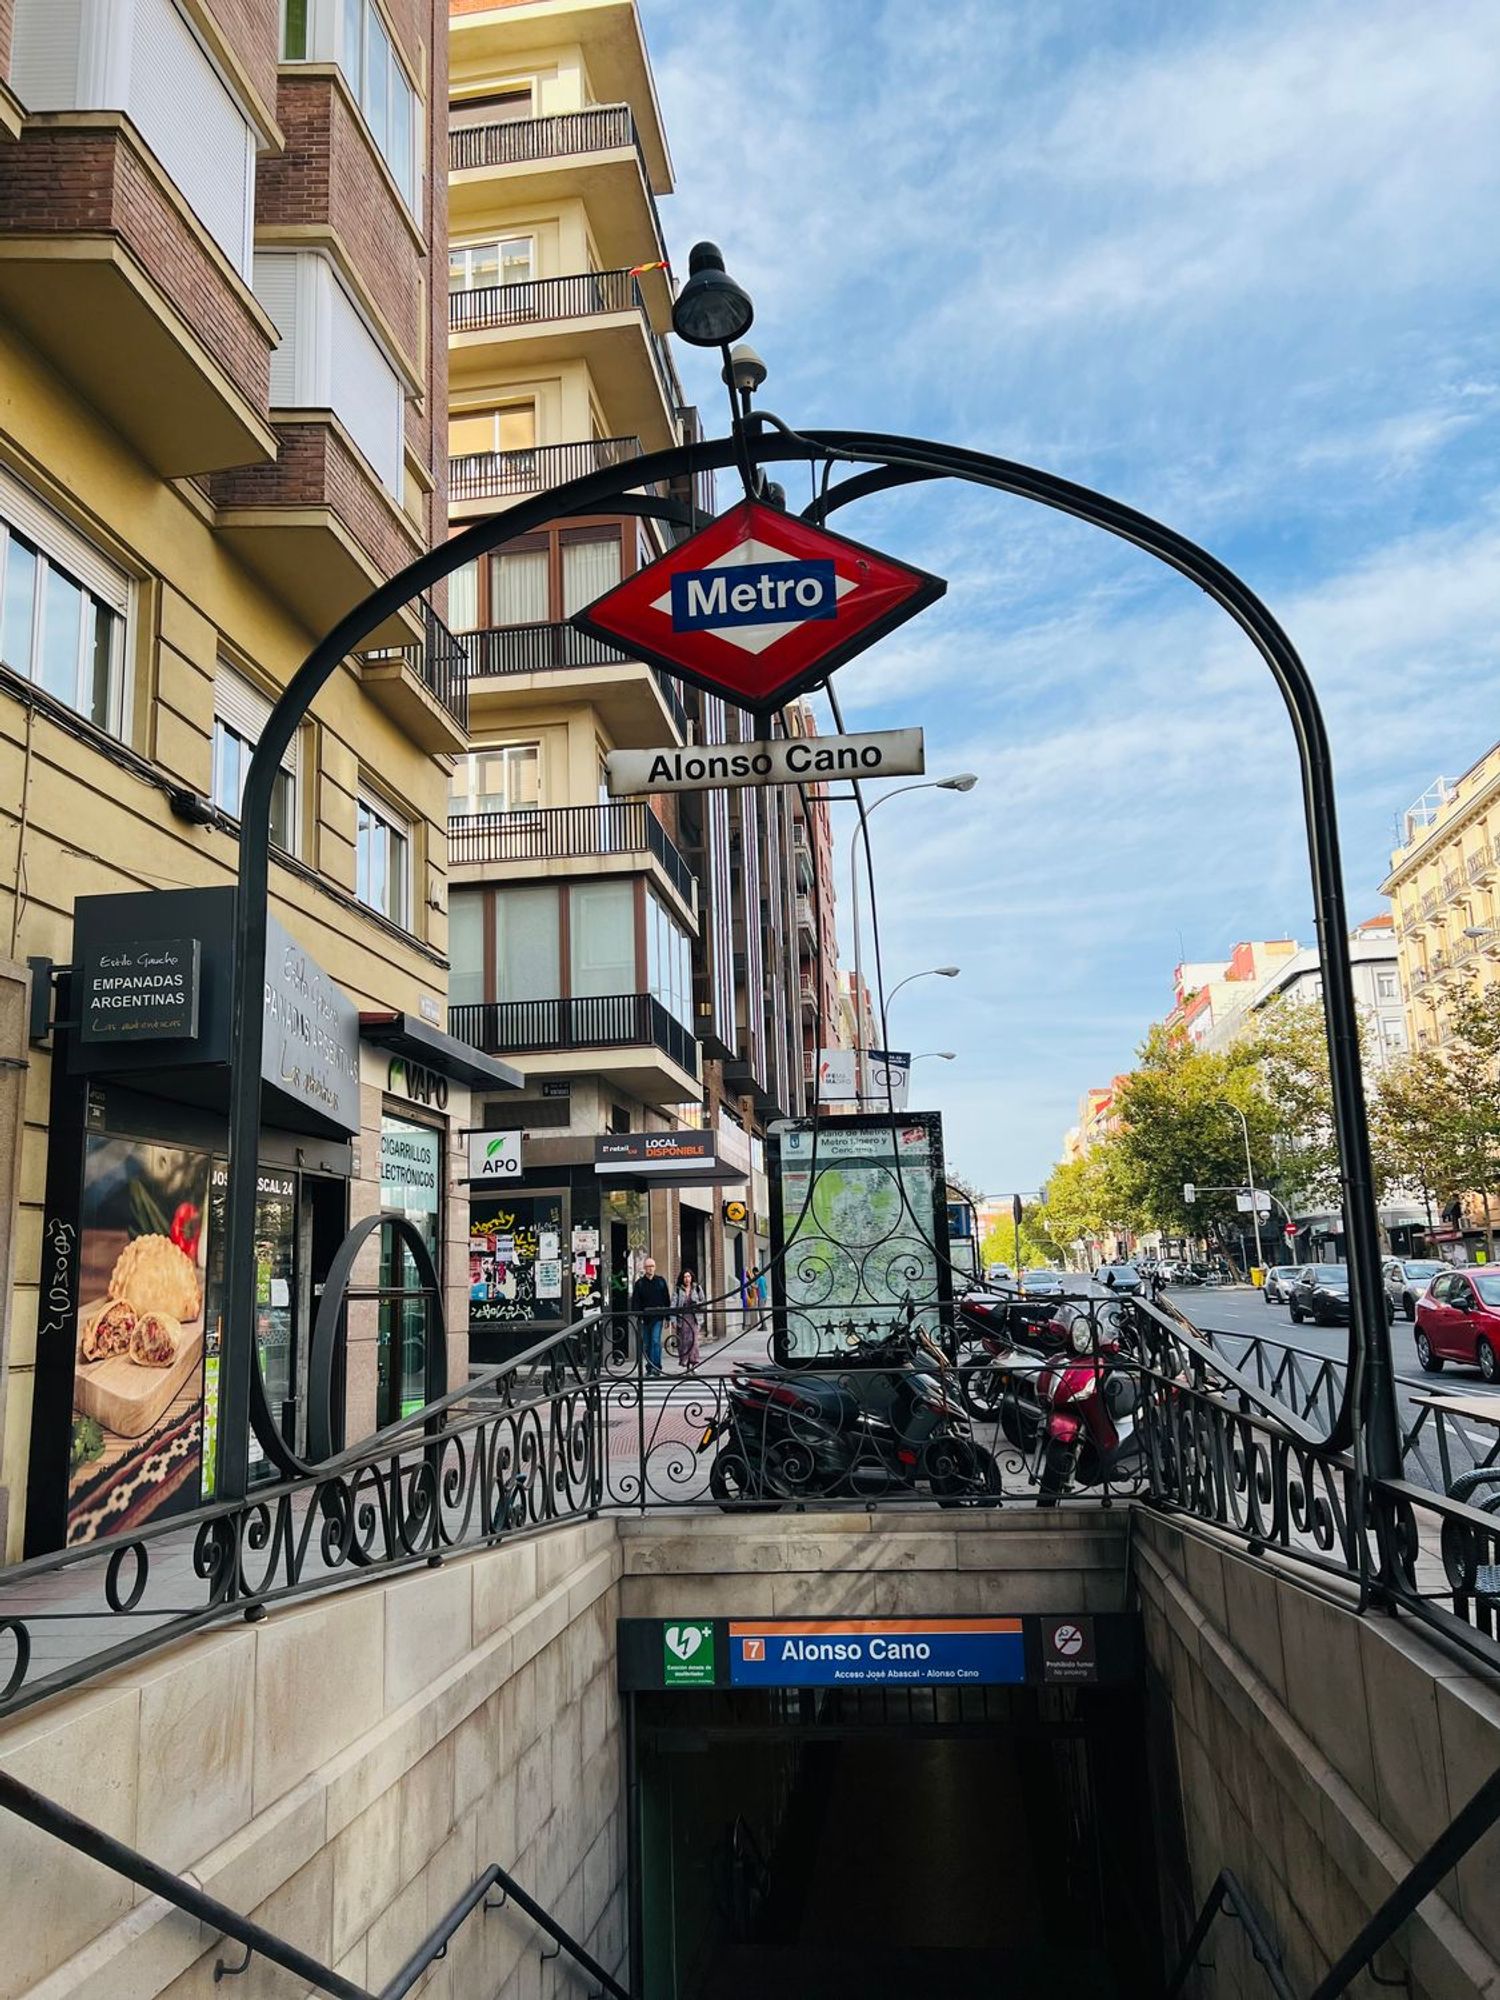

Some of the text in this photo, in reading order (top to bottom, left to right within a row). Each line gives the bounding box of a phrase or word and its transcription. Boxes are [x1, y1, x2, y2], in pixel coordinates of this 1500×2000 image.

[686, 573, 824, 618] Metro
[648, 744, 883, 783] Alonso Cano
[93, 974, 183, 991] EMPANADAS
[90, 992, 185, 1009] ARGENTINAS
[264, 981, 311, 1046] PANADAS
[381, 1136, 431, 1164] CIGARRILLOS
[645, 1138, 679, 1149] LOCAL
[645, 1146, 705, 1157] DISPONIBLE
[820, 1138, 849, 1147] Metro
[381, 1161, 435, 1188] LECTRÓNICOS
[482, 1158, 518, 1174] APO
[211, 1170, 294, 1195] JOS SCAL 24
[748, 1638, 931, 1661] 7 Alonso Cano
[834, 1670, 865, 1679] Acceso
[866, 1669, 885, 1680] José
[887, 1669, 920, 1678] Abascal
[926, 1669, 956, 1678] Alonso
[957, 1669, 979, 1678] Cano
